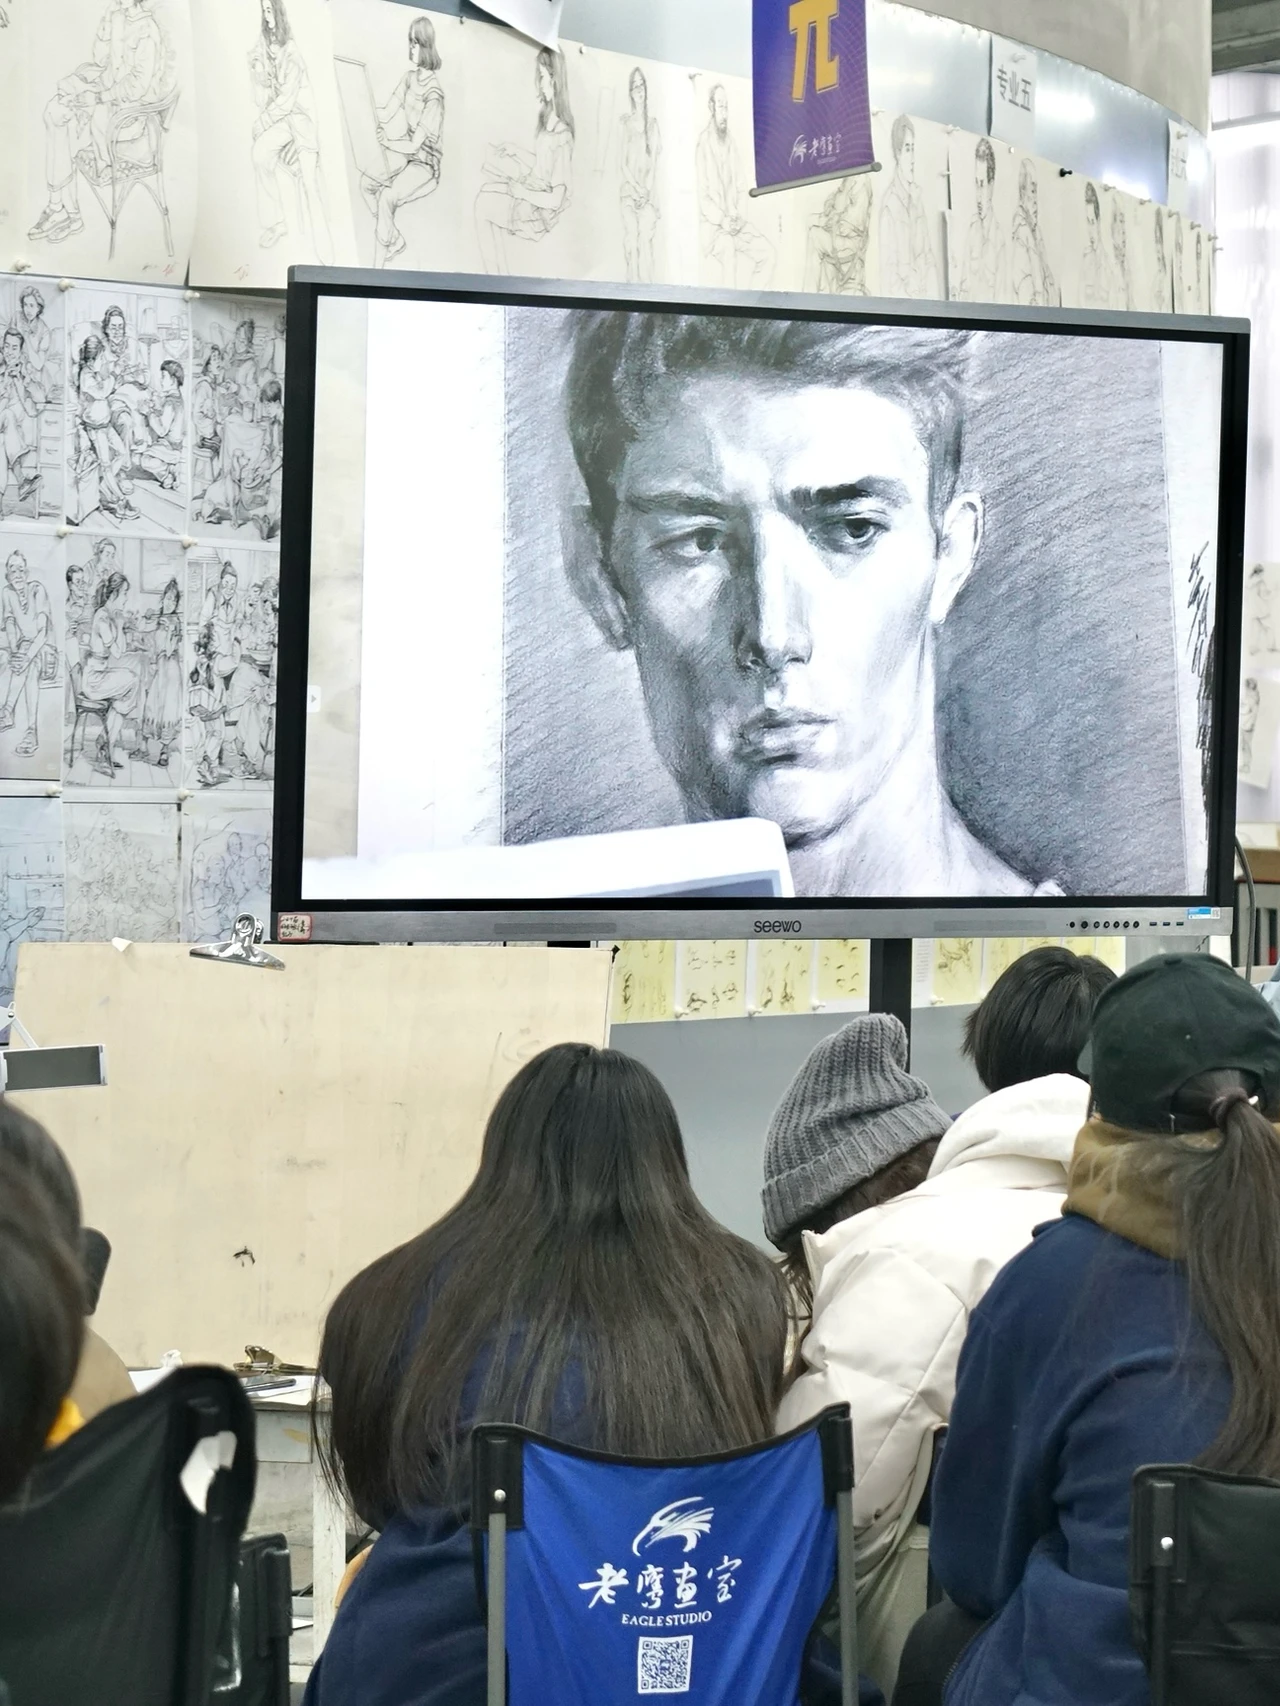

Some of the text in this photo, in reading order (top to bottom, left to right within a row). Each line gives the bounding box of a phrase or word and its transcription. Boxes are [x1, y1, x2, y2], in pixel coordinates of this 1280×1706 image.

[996, 64, 1032, 112] 专业五
[621, 1610, 713, 1627] EAGLE STUDIO
